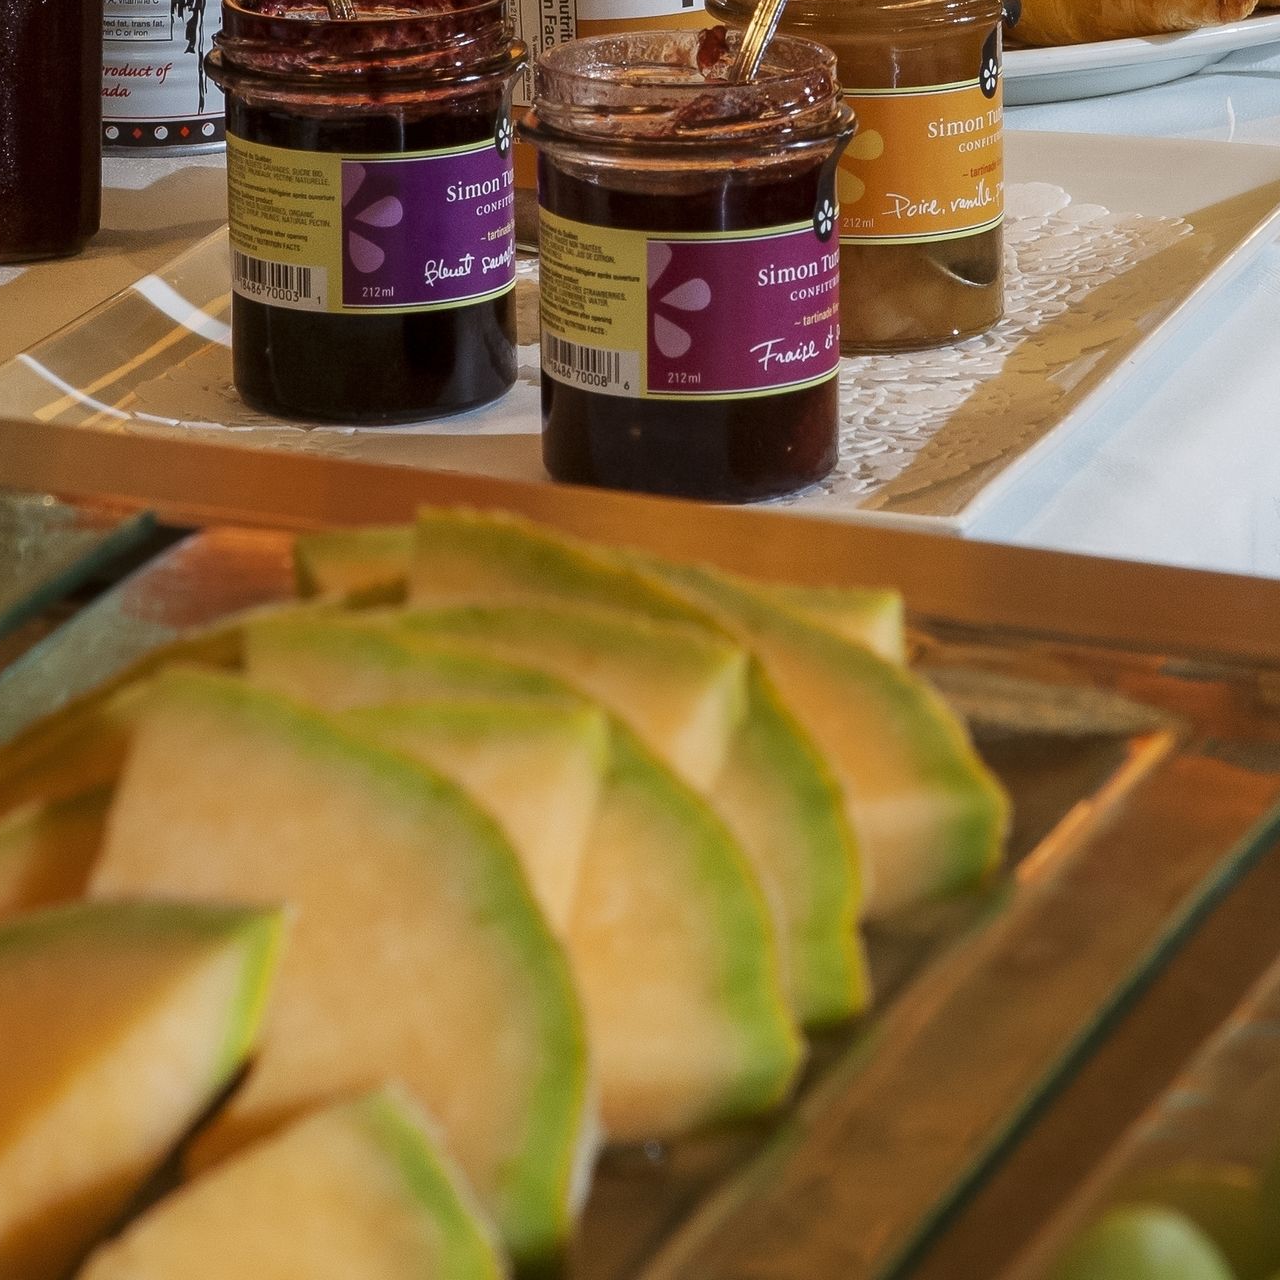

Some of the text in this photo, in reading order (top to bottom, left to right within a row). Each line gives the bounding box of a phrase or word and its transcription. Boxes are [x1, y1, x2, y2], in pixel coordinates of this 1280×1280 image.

[115, 29, 122, 37] C
[133, 29, 149, 37] iron
[131, 20, 151, 28] trans
[103, 62, 173, 85] roduct of
[927, 115, 984, 139] Simon
[446, 177, 500, 203] Simon
[882, 193, 946, 219] Poire,
[424, 253, 476, 287] Bleuet
[757, 261, 818, 287] Simon
[266, 286, 300, 303] 70003
[317, 296, 322, 305] 1
[749, 337, 820, 371] Fraise
[575, 369, 609, 388] 70008
[623, 381, 631, 391] 6
